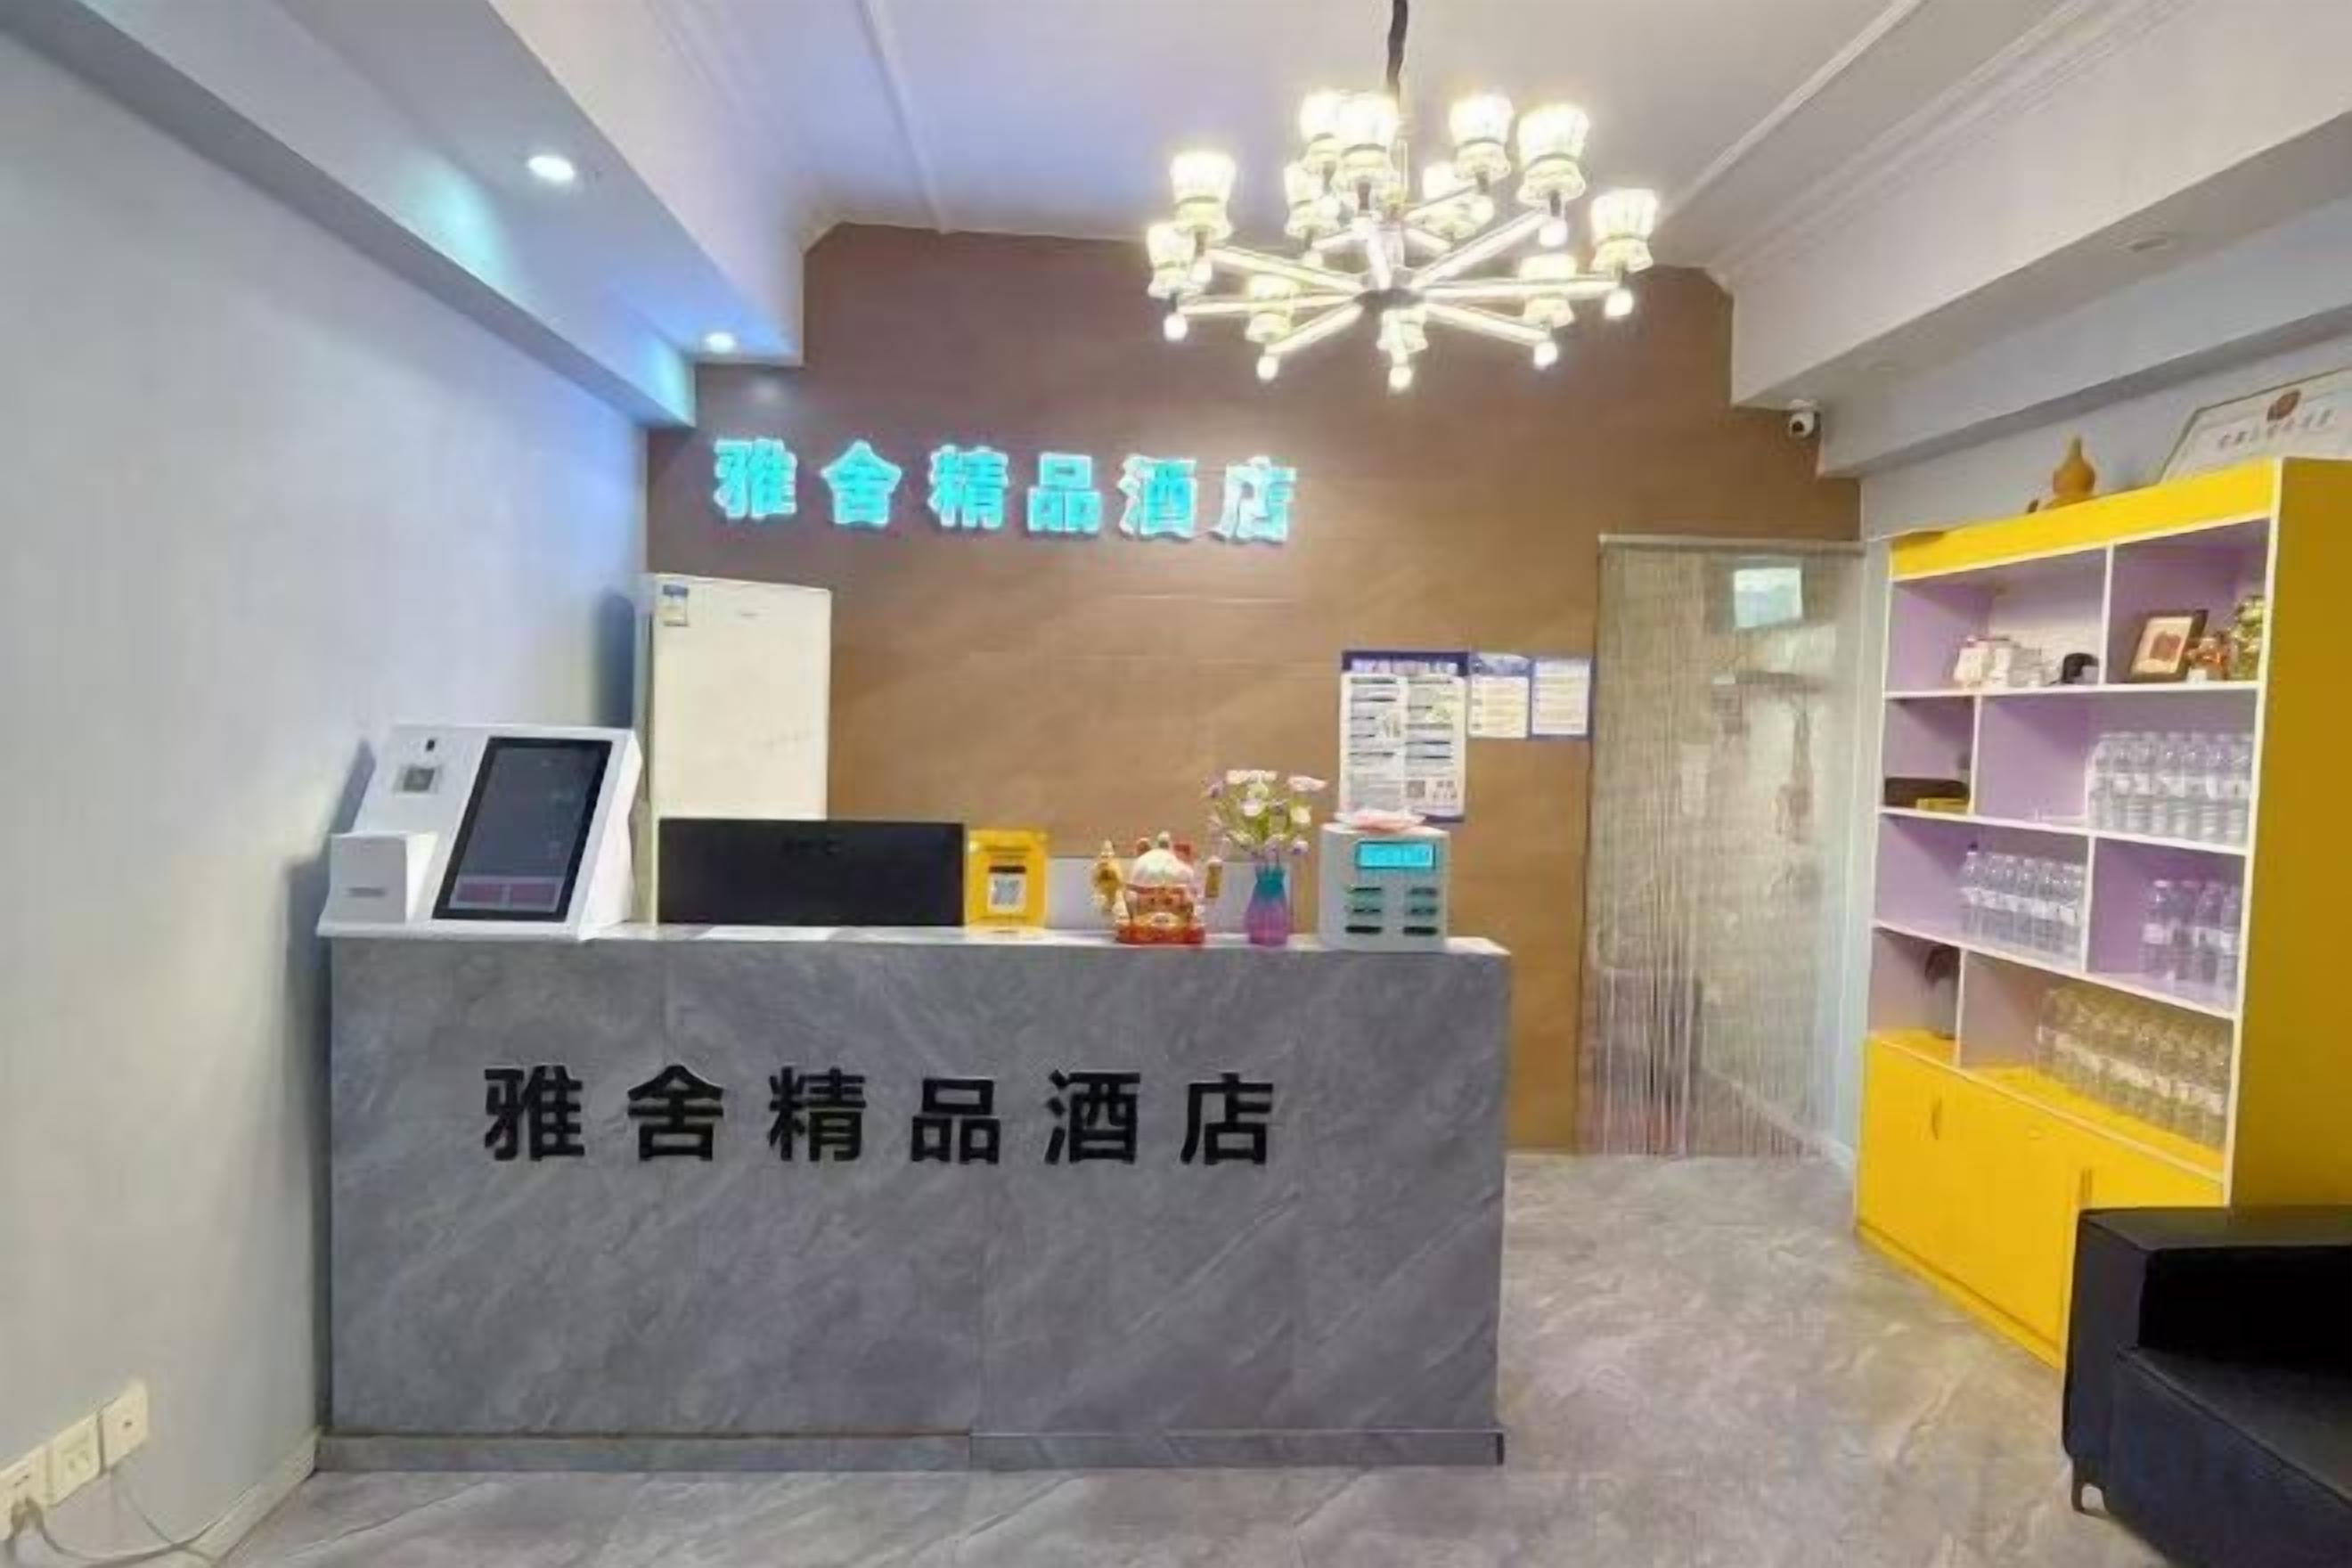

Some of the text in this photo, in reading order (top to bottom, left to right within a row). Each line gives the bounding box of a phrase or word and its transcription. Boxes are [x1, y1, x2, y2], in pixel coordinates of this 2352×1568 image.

[713, 437, 1297, 542] 雅舍精品酒店
[484, 1064, 1274, 1165] 雅舍精品酒店
